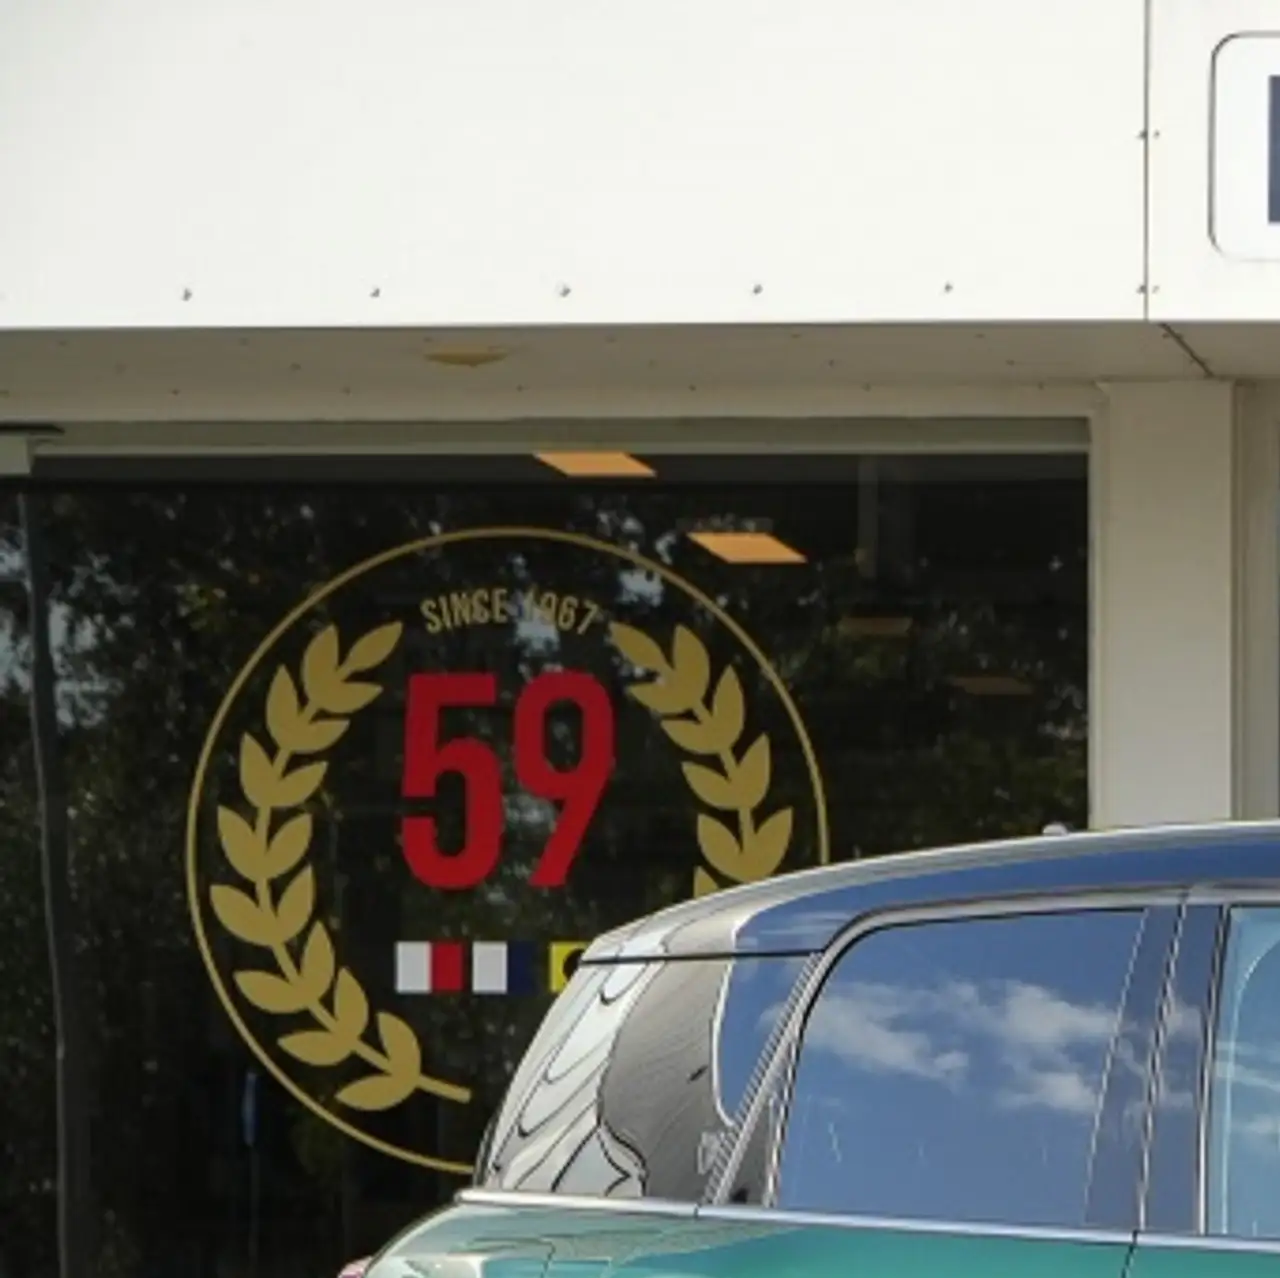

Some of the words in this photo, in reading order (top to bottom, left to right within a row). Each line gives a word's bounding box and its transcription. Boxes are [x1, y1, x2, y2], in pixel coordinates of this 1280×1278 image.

[420, 588, 508, 634] SINCE
[522, 584, 599, 635] 1967
[402, 669, 617, 890] 59
